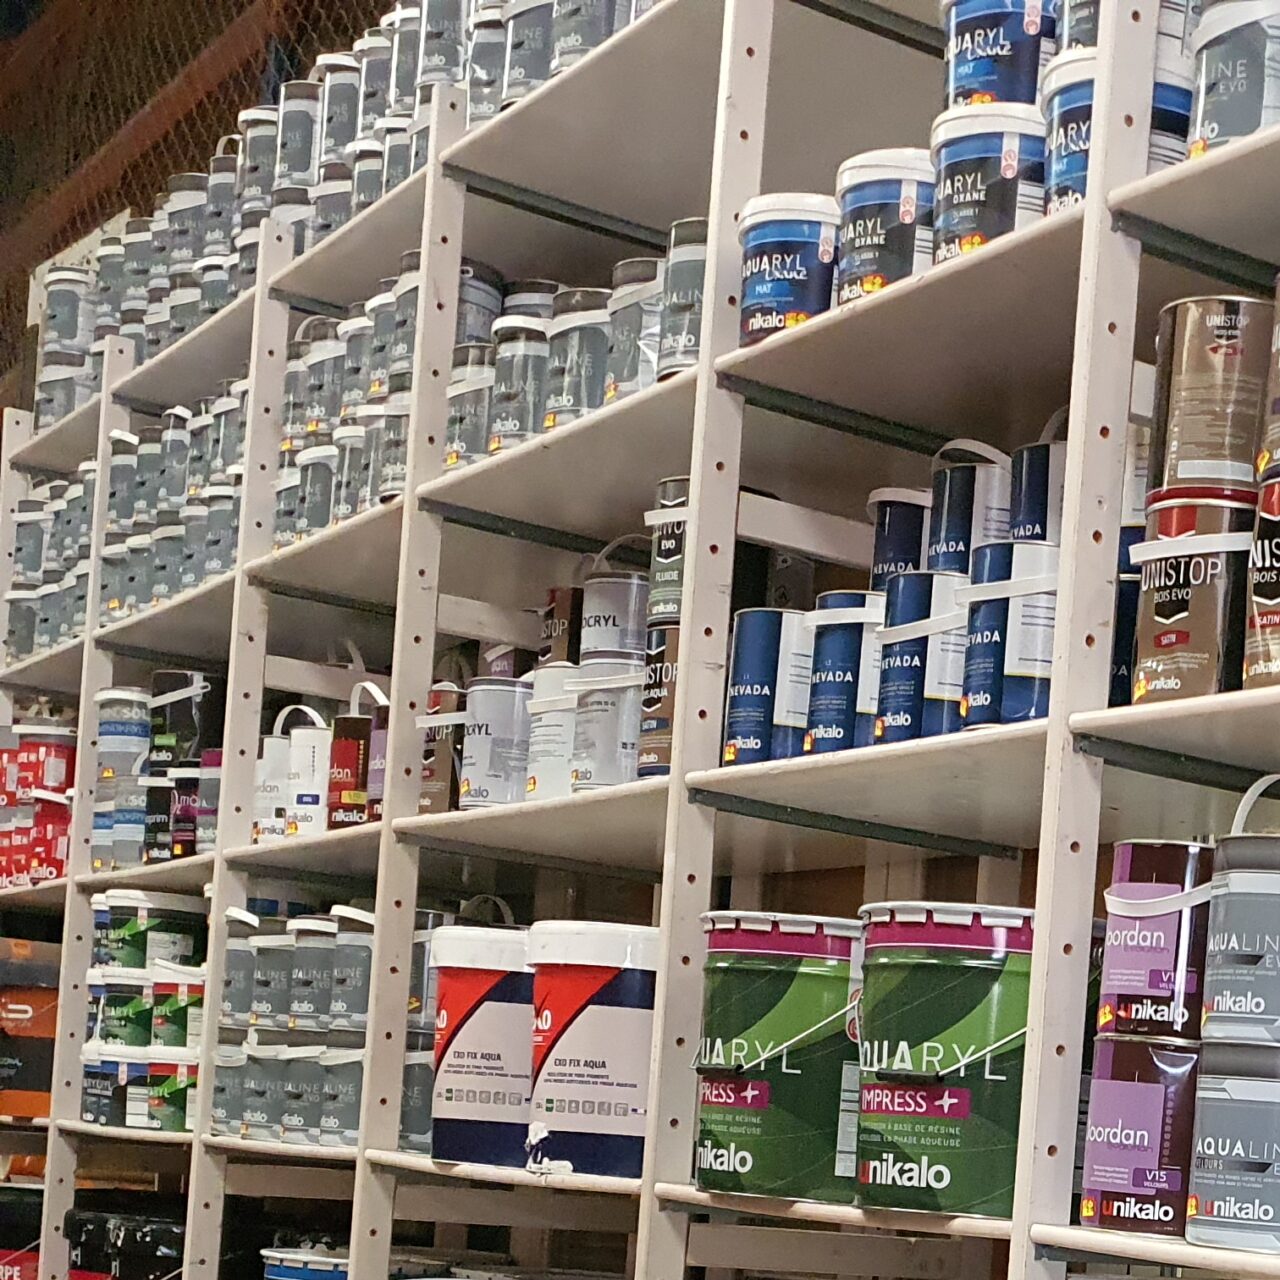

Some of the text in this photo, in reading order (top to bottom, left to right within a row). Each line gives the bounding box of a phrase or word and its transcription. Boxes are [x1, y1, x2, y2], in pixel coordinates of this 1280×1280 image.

[953, 191, 986, 204] OXANE
[855, 235, 885, 247] OXANE
[756, 284, 772, 295] MAT
[1142, 557, 1222, 591] UNISTOP
[1253, 571, 1277, 583] BOIS
[1171, 588, 1192, 600] EVO
[467, 1052, 477, 1060] FIX
[480, 1052, 502, 1061] AQUA
[569, 1059, 580, 1067] FIX
[583, 1060, 606, 1069] AQUA
[1146, 1170, 1167, 1181] V15
[1102, 1197, 1174, 1221] unikalo
[1204, 1197, 1274, 1220] unikalo
